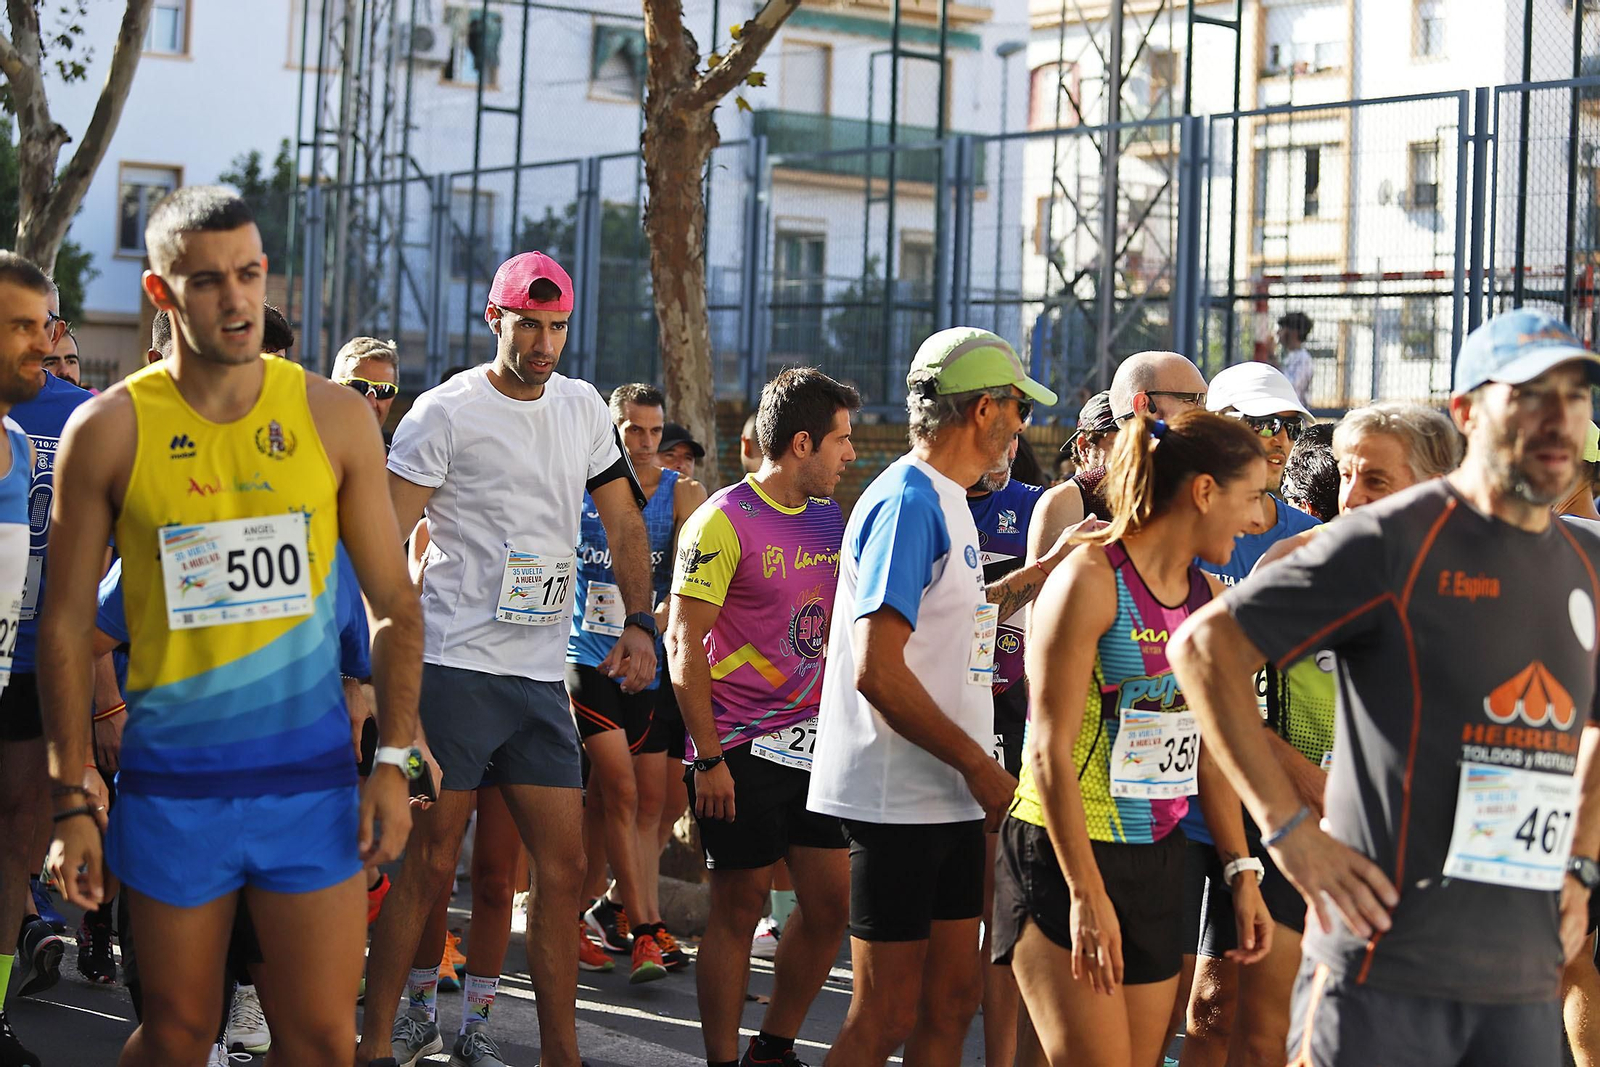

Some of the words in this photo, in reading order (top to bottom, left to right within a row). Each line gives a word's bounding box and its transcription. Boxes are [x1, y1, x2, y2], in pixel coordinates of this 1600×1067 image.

[243, 523, 276, 536] ANGEL
[189, 552, 221, 570] HUELVA
[227, 543, 301, 592] 500
[543, 575, 570, 605] 178
[1136, 738, 1162, 748] HUELVA
[1139, 728, 1163, 739] VUELTA
[1159, 733, 1197, 773] 358
[1462, 744, 1523, 766] TOLDOS
[1515, 806, 1571, 854] 467
